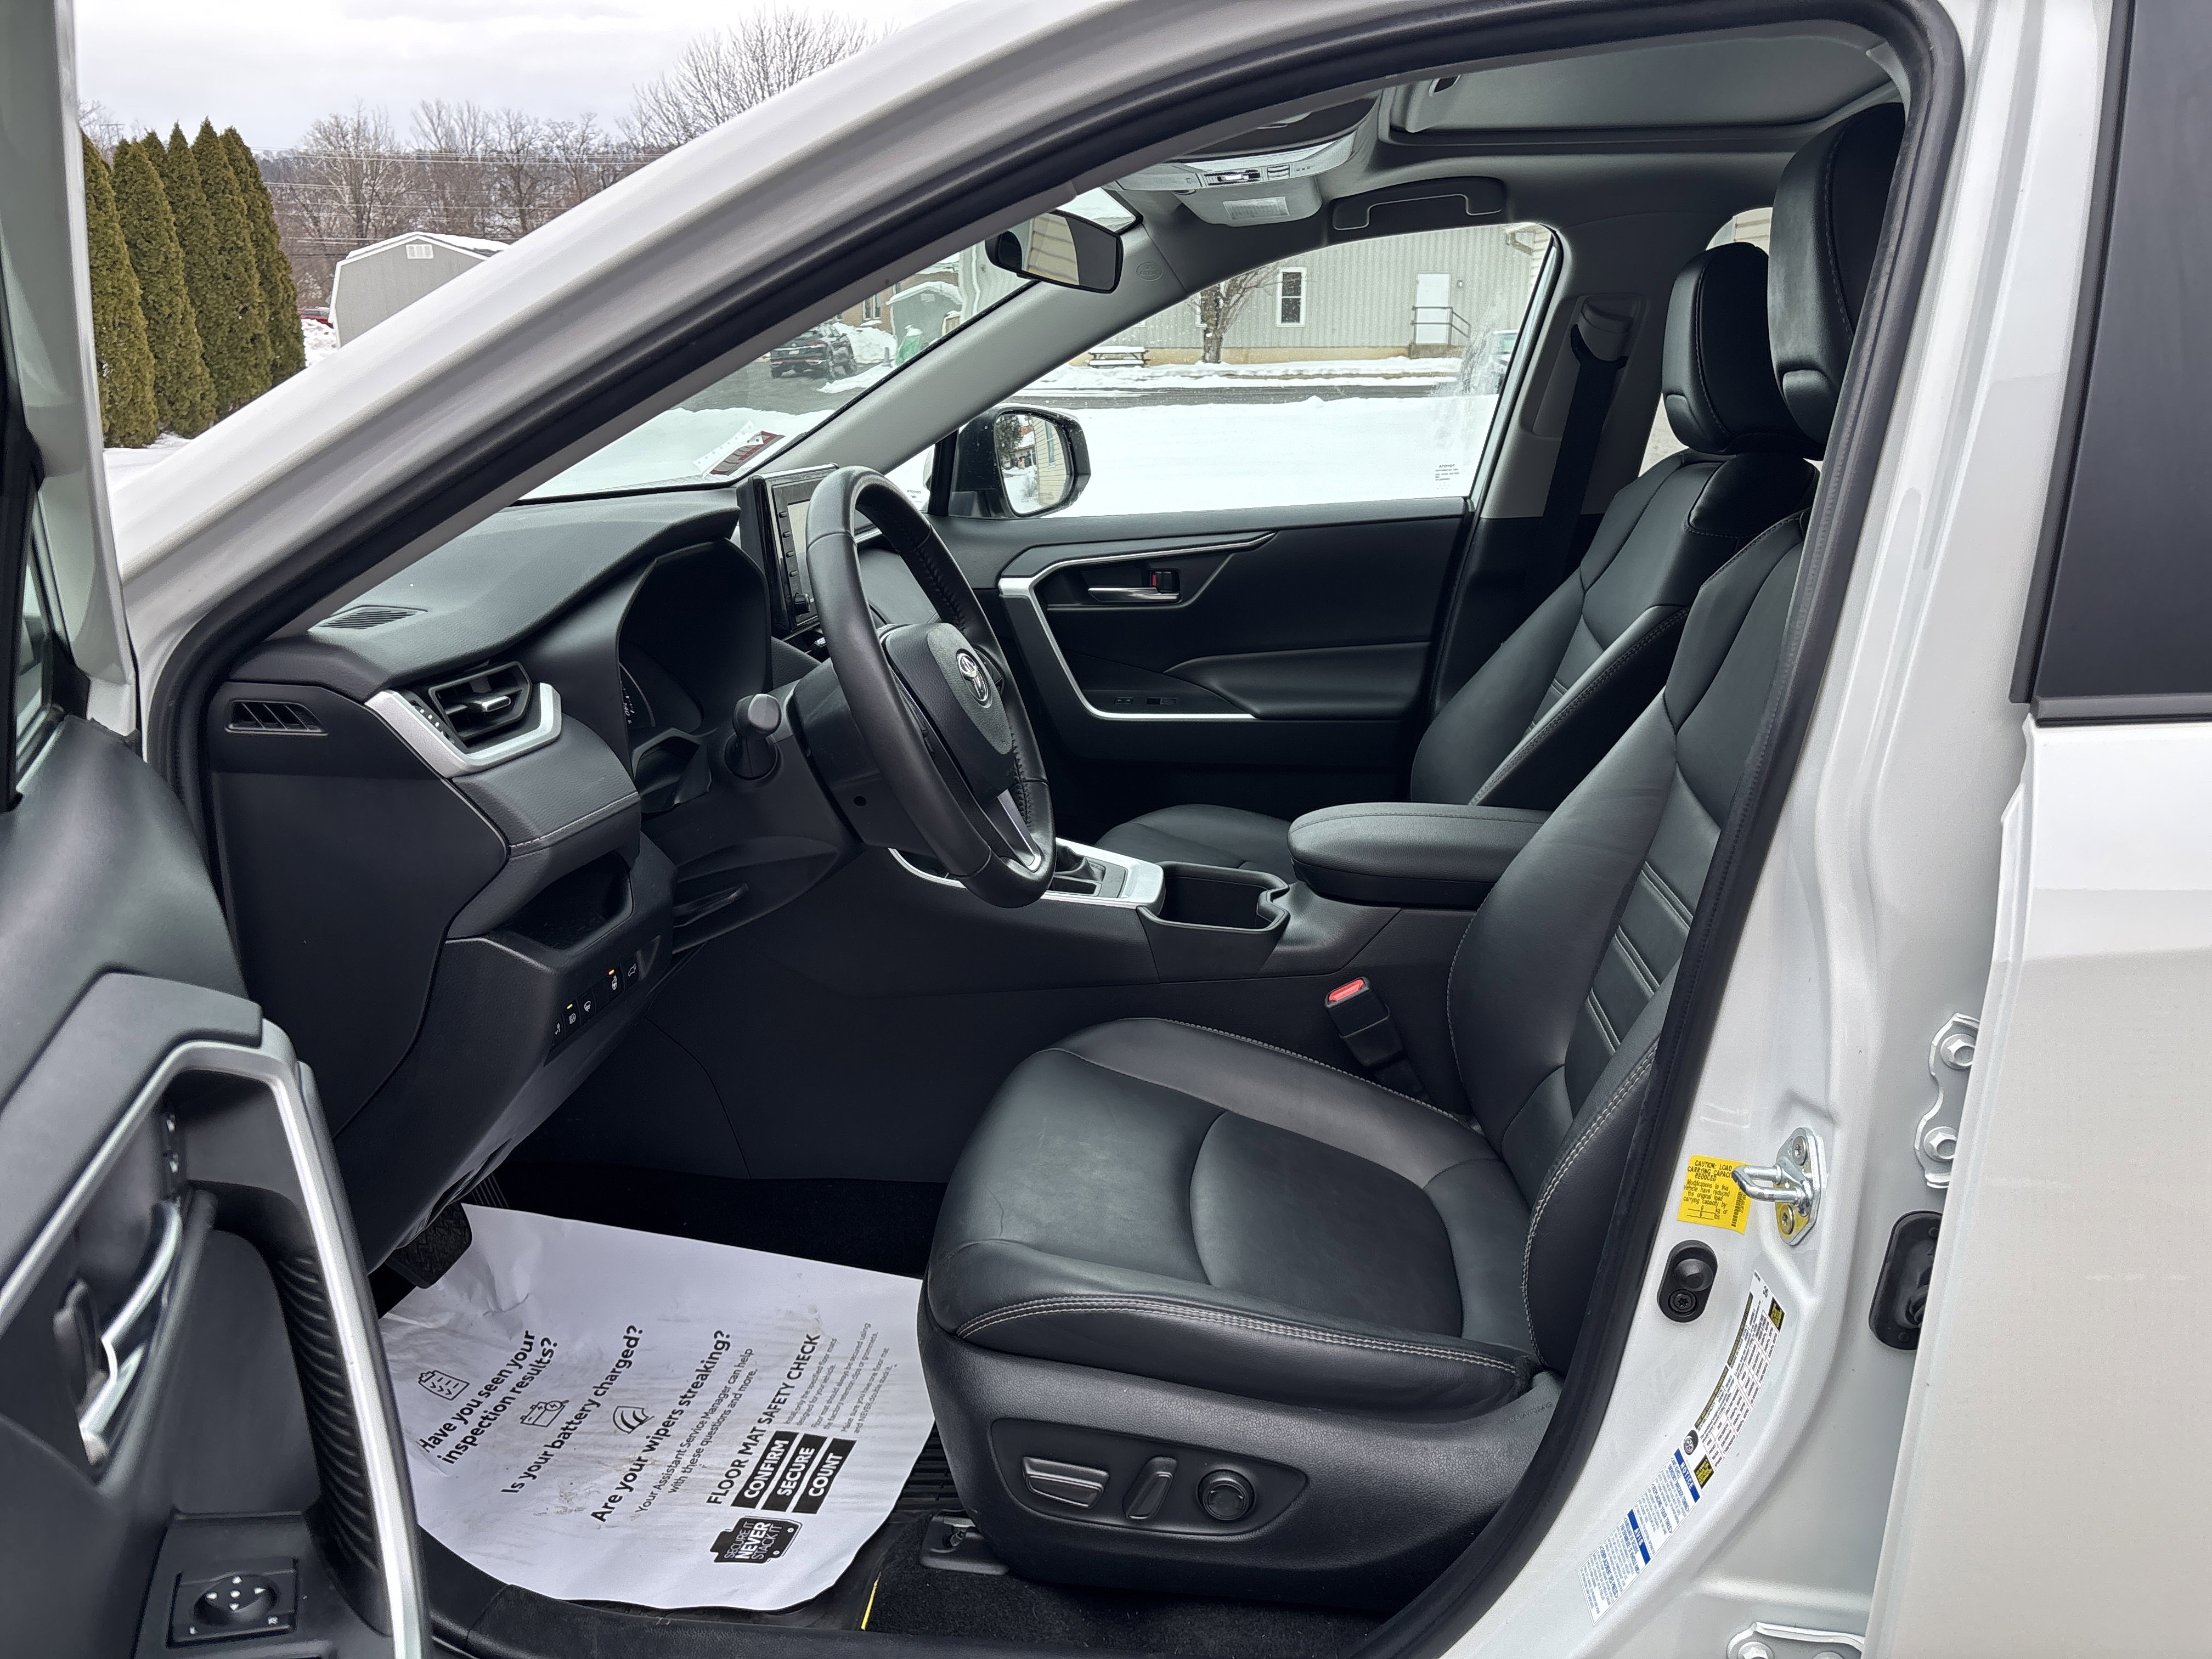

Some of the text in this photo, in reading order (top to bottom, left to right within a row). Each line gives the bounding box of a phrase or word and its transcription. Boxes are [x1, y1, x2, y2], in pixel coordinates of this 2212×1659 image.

[1688, 1166, 1711, 1175] CARRYING
[1695, 1160, 1717, 1169] CAUTION:
[1695, 1173, 1717, 1182] REDUCED
[860, 1323, 872, 1340] using
[416, 1330, 535, 1453] Have you seen your
[437, 1337, 558, 1464] inspection results?
[500, 1324, 643, 1493] Is your battery charged?
[590, 1330, 731, 1522] Are your wipers streaking?
[635, 1348, 753, 1513] Your Assistant Service Manager can help
[668, 1368, 759, 1493] with these questions and more.
[706, 1334, 821, 1505] FLOOR MAT SAFETY CHECK
[744, 1439, 789, 1499] CONFIRM
[777, 1447, 816, 1497] SECURE
[809, 1452, 843, 1498] COUNT
[1680, 1462, 1694, 1489] NOTICE
[724, 1529, 751, 1559] SECURE
[735, 1522, 771, 1559] NEVER
[751, 1523, 782, 1560] STACK IT
[1634, 1528, 1644, 1546] AVIS
